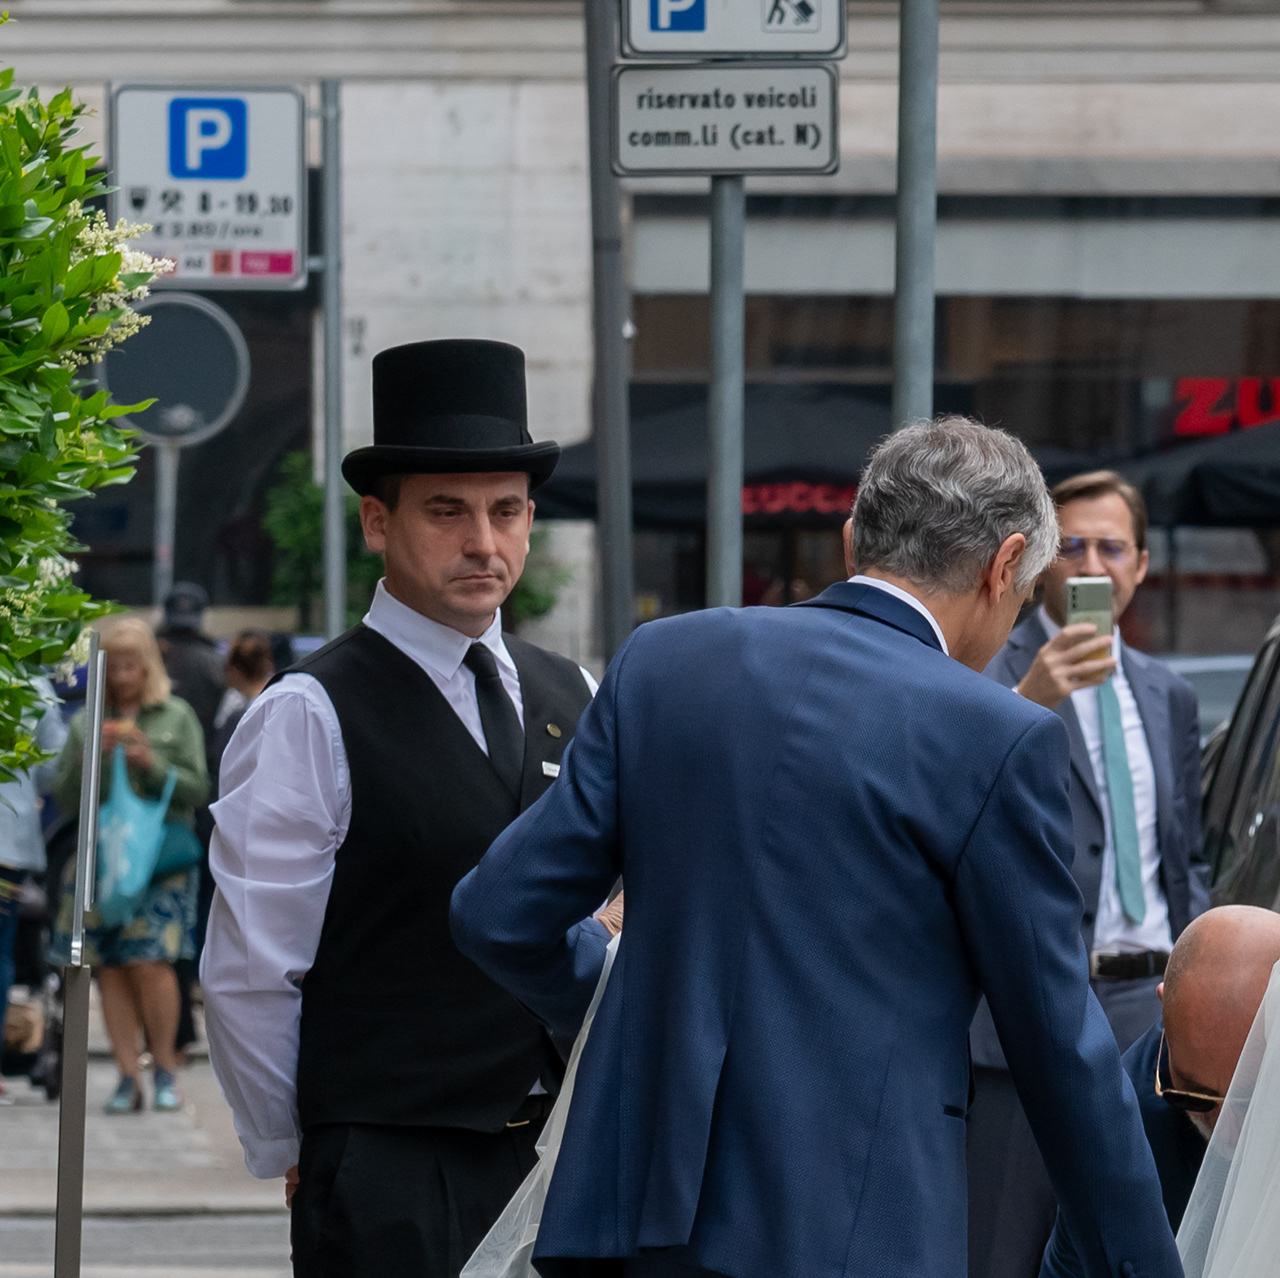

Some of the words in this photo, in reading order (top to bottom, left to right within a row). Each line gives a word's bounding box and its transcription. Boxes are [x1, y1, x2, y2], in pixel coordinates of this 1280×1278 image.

[637, 87, 735, 109] riservato
[743, 86, 817, 108] veicoli
[185, 107, 233, 171] P
[628, 123, 718, 147] comm.li
[730, 123, 785, 150] (cat.
